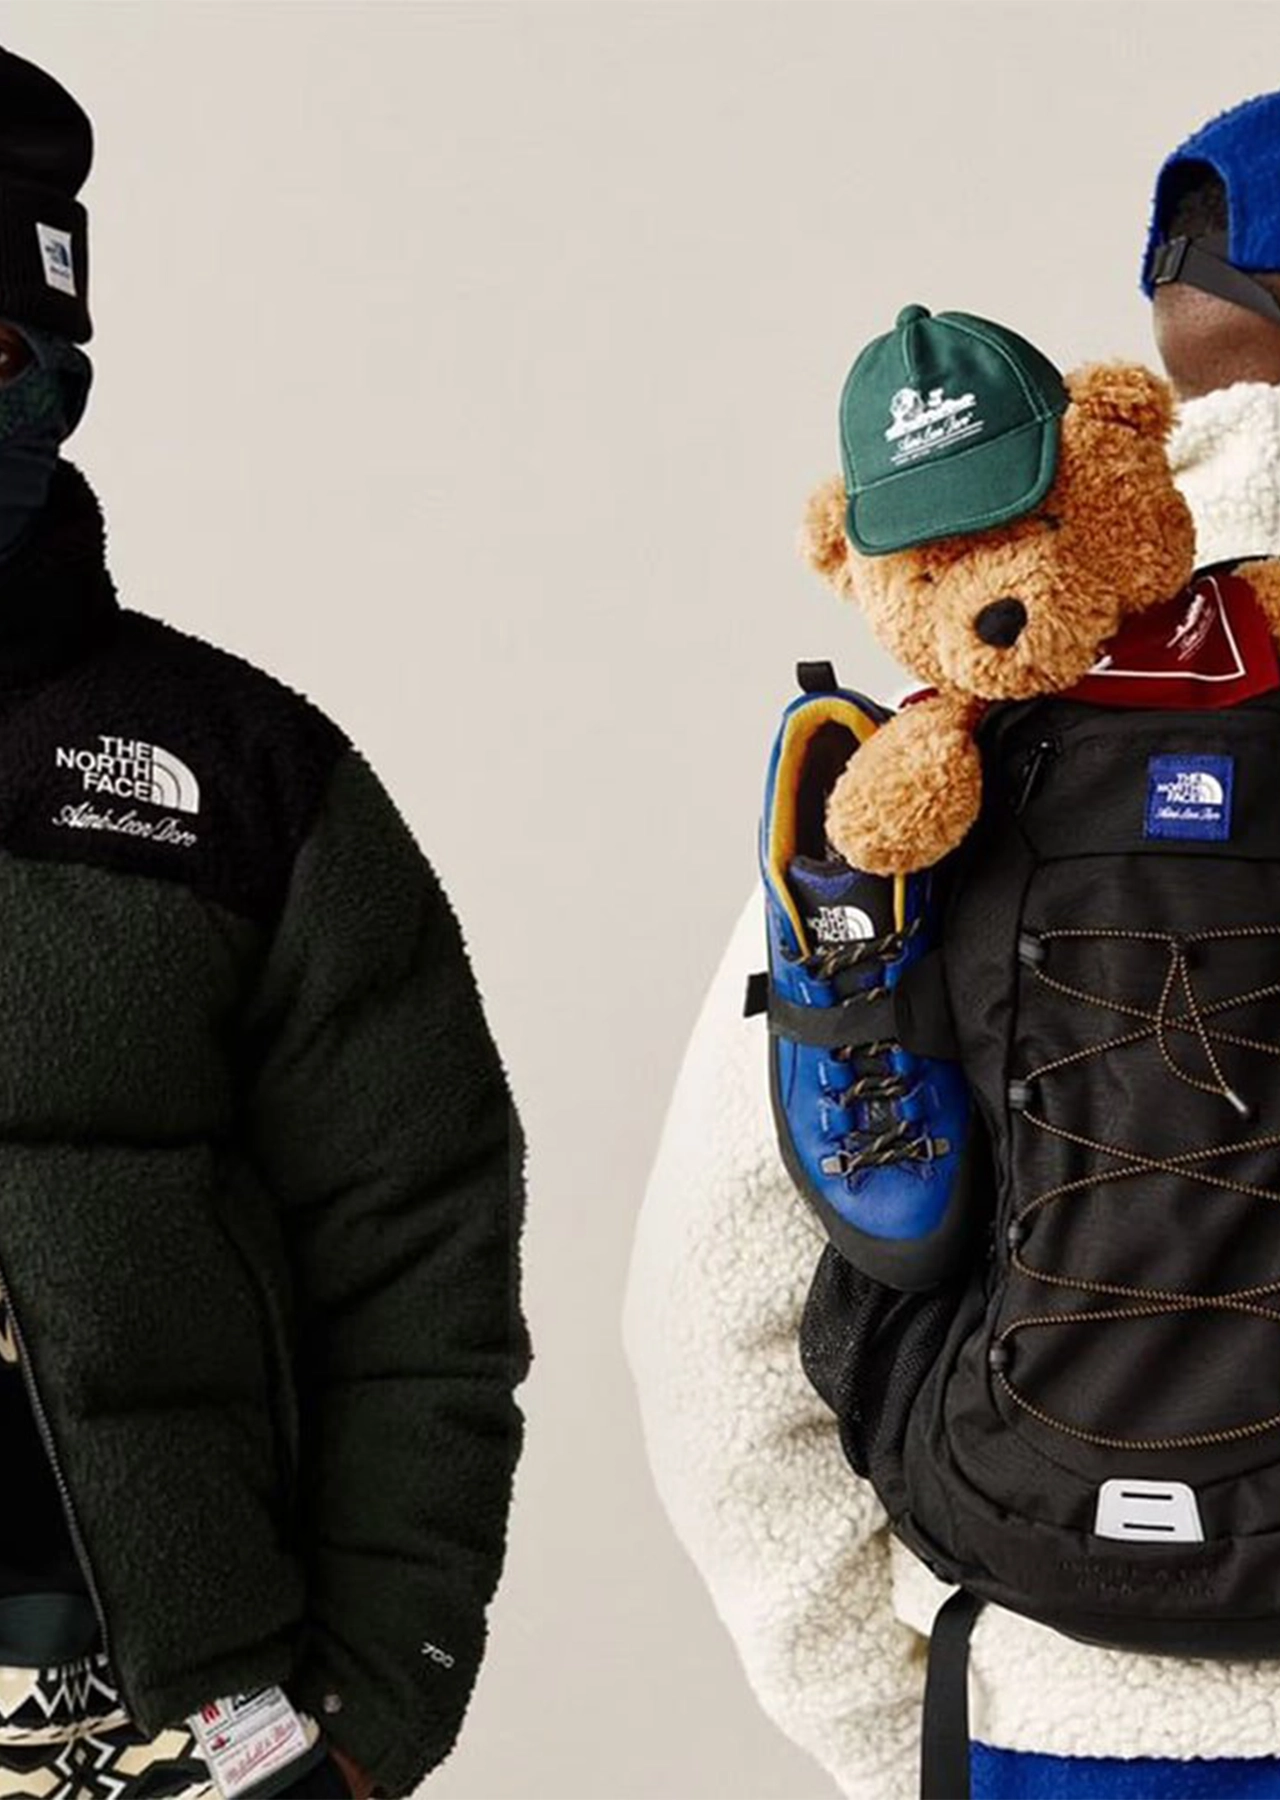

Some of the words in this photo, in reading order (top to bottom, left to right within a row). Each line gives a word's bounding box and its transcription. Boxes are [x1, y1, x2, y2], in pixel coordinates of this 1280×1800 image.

[98, 735, 152, 762] THE
[56, 747, 150, 781] NORTH
[83, 771, 151, 803] FACE
[1177, 773, 1201, 784] THE
[818, 906, 845, 921] THE
[421, 1641, 455, 1669] 700
